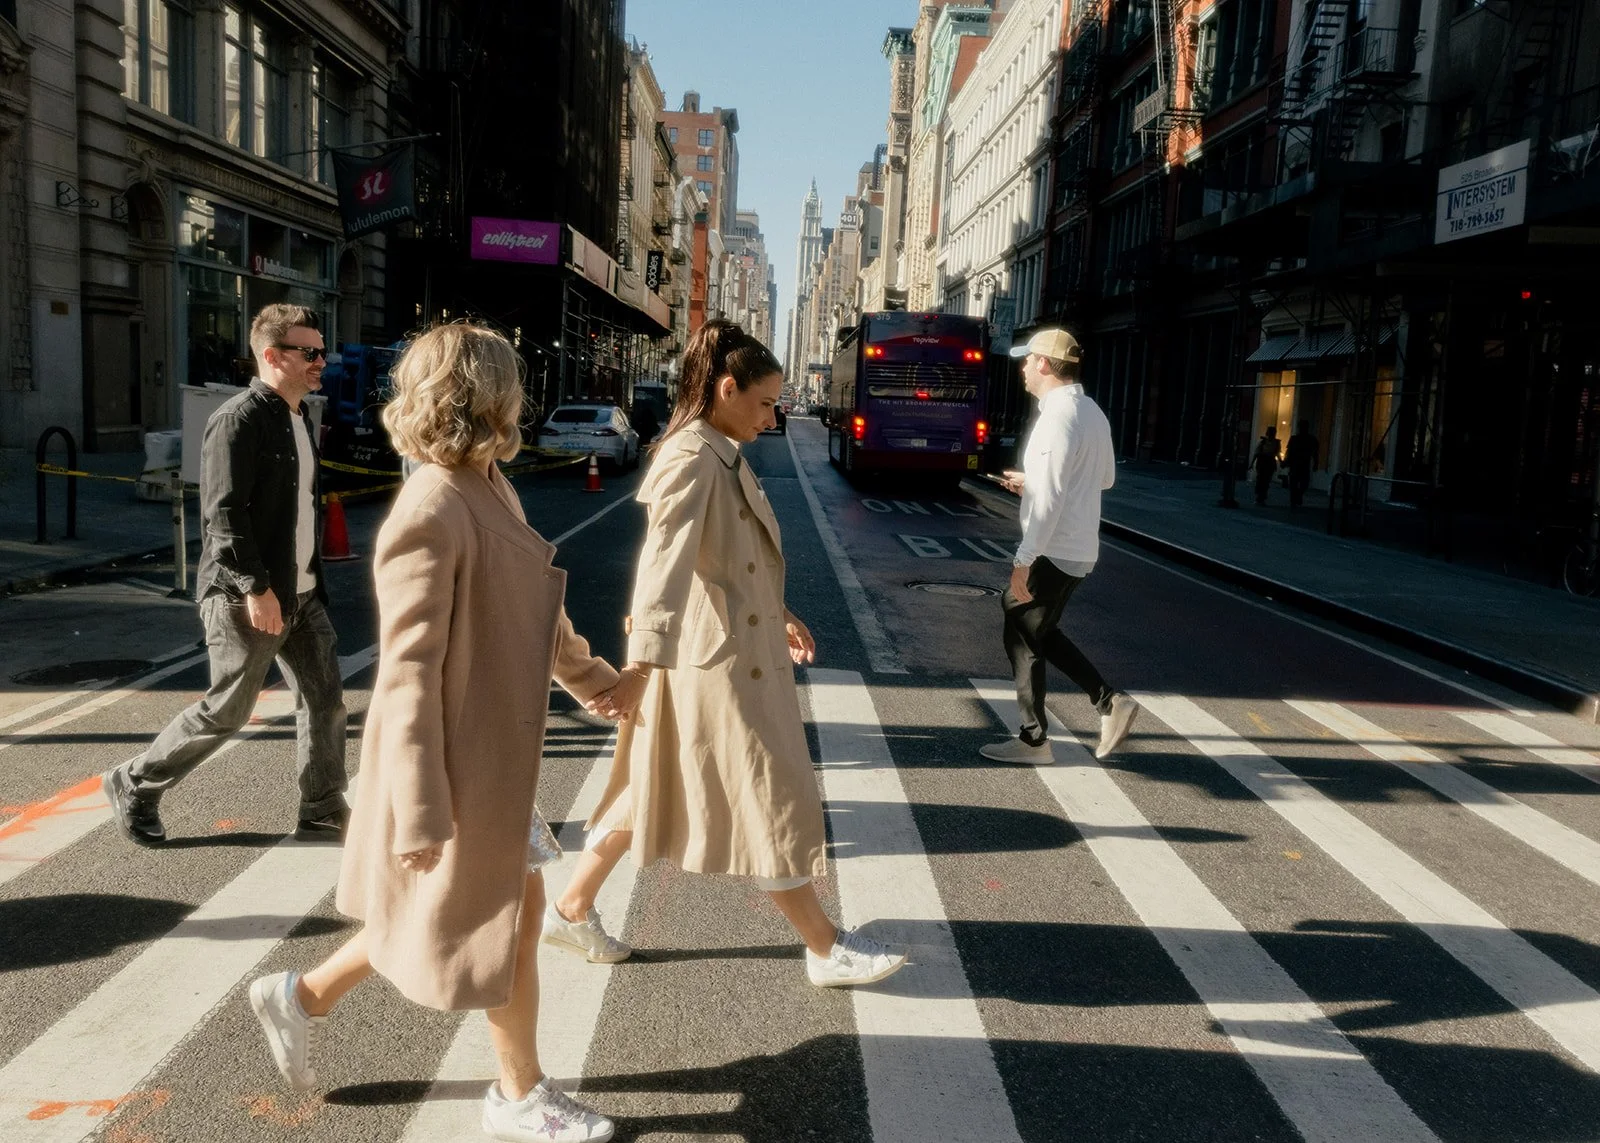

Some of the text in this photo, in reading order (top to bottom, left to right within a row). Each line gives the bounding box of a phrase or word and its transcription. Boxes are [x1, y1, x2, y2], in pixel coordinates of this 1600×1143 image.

[1445, 175, 1516, 221] INTERSYSTEM
[347, 205, 410, 232] lululemon
[841, 214, 857, 223] 401
[876, 312, 892, 321] 375
[861, 499, 1000, 519] ONLY
[895, 534, 1016, 563] BU
